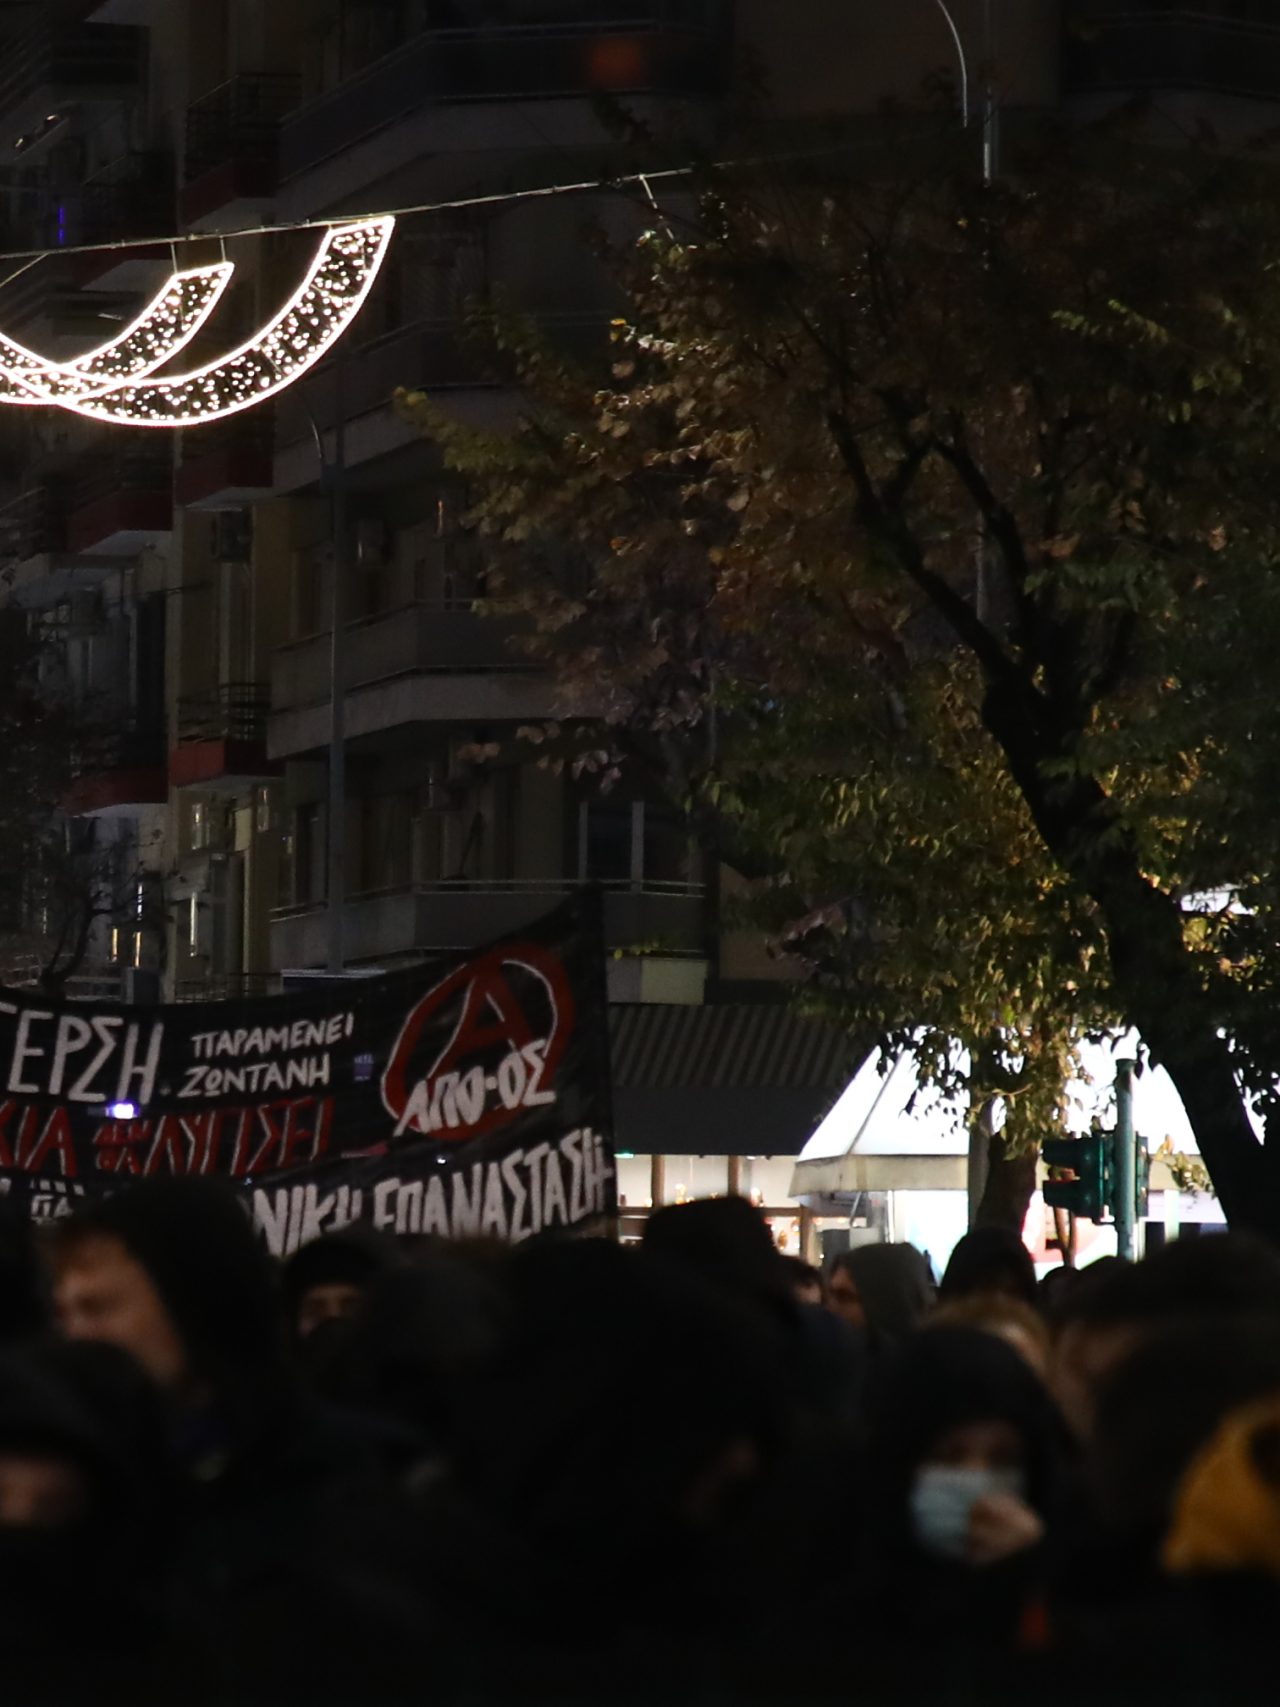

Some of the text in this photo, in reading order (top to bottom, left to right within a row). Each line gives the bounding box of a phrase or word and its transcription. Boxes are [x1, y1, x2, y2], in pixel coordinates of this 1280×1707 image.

[191, 1012, 354, 1058] ΠΑΡΑΜΕΝΕΙ
[177, 1053, 331, 1098] ΖΩΝΤΑΝΗ
[373, 1127, 614, 1244] ΕΠΑΝΑΣΤΑΣΗ
